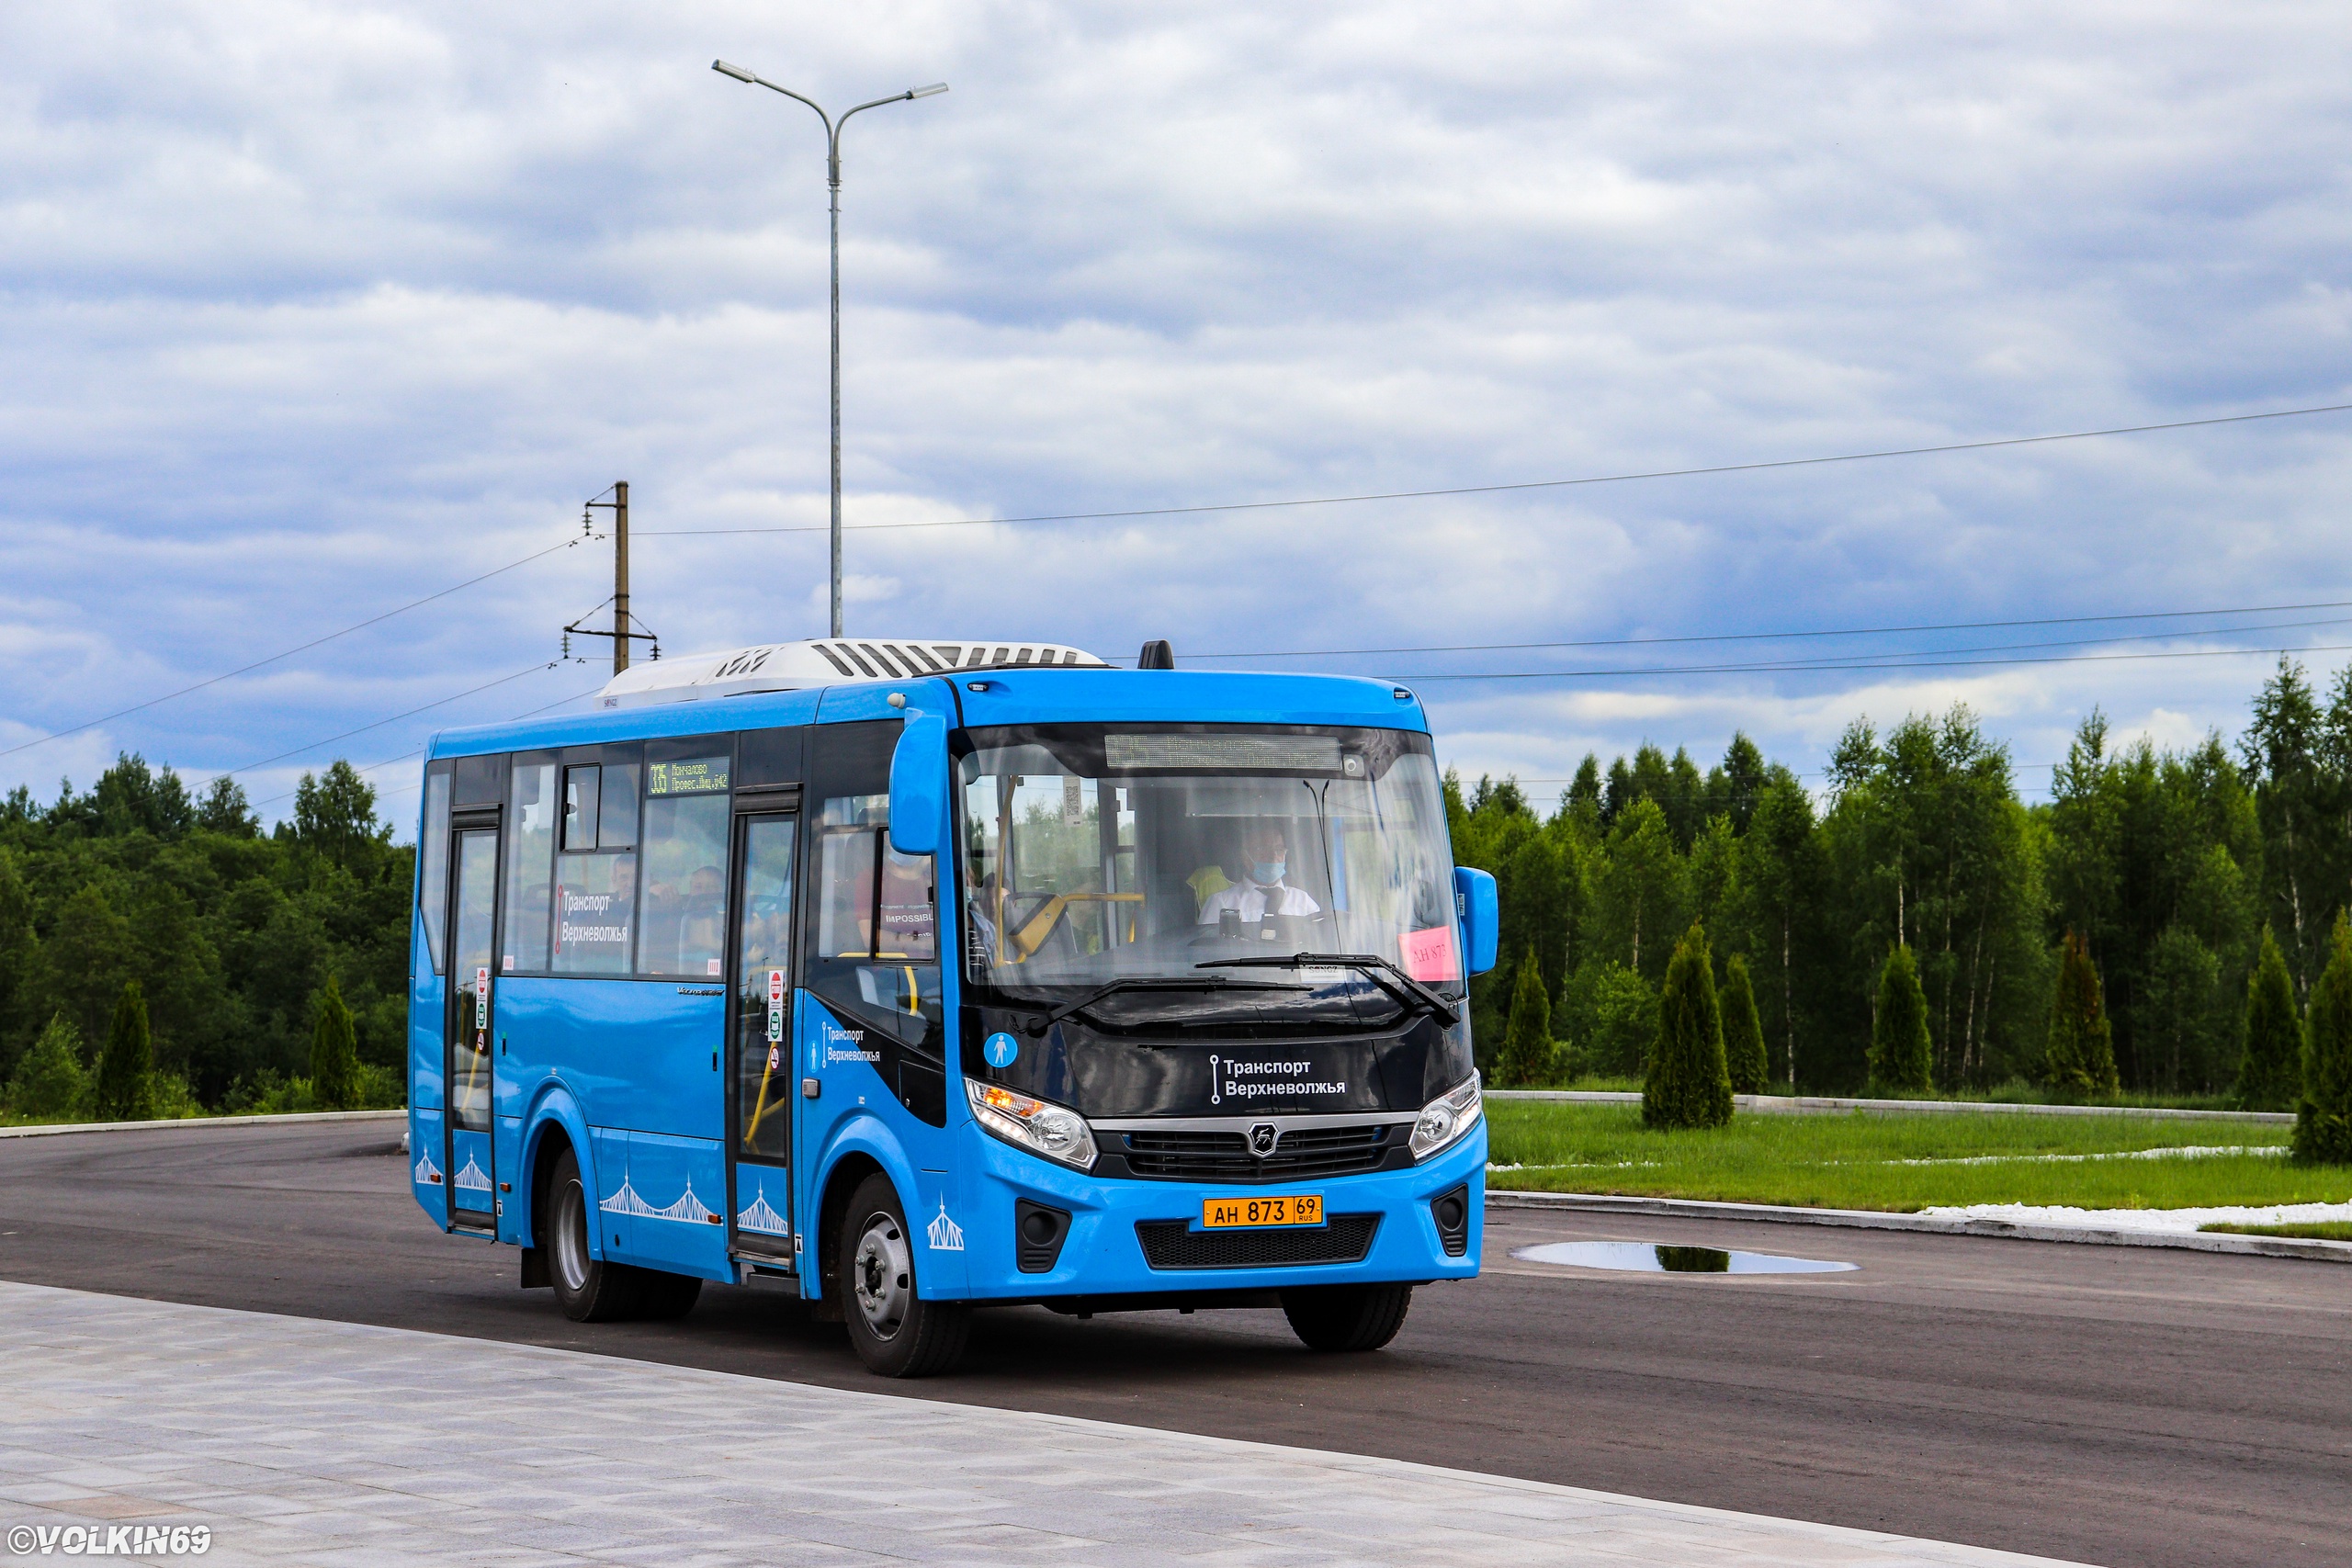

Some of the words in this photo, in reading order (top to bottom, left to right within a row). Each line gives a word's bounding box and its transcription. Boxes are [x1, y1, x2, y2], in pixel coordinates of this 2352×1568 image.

[563, 890, 610, 917] Транспорт
[561, 920, 628, 947] Верхневолжья
[1430, 943, 1448, 960] 873
[1308, 965, 1339, 974] SONGZ
[827, 1026, 865, 1044] Транспорт
[827, 1046, 881, 1065] Верхневолжья
[1223, 1059, 1311, 1078] Транспорт
[1225, 1080, 1346, 1100] Верхневолжья
[1247, 1200, 1285, 1223] 873
[1296, 1198, 1316, 1214] 69
